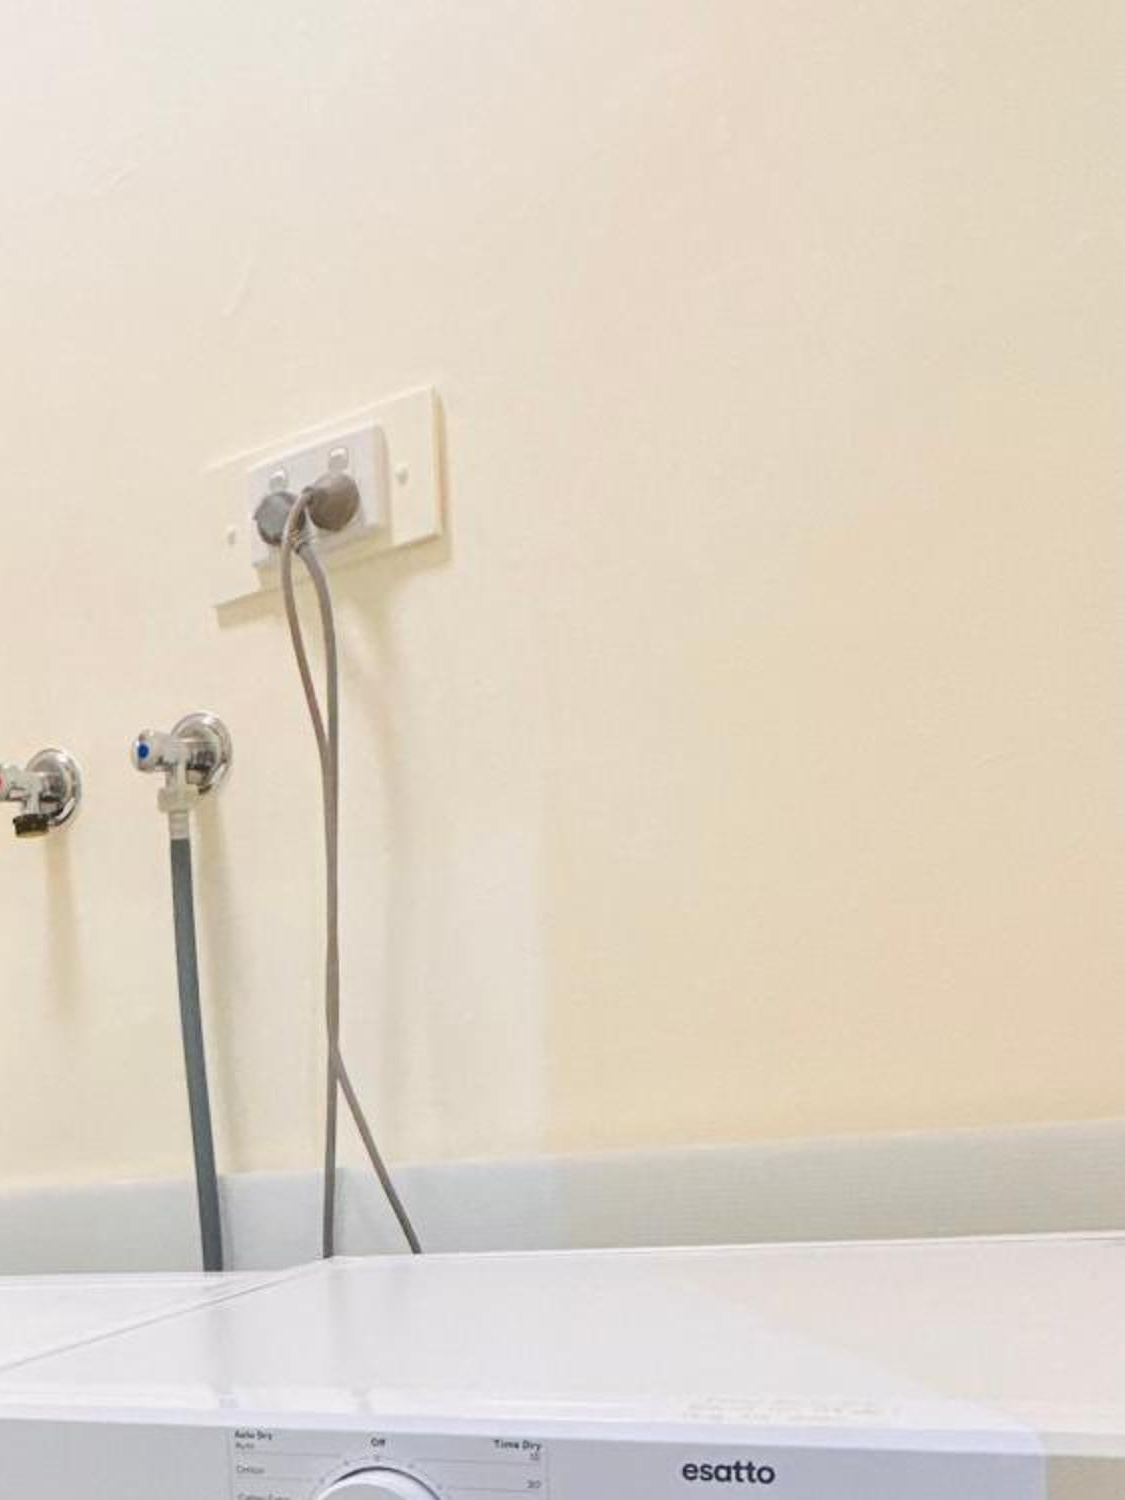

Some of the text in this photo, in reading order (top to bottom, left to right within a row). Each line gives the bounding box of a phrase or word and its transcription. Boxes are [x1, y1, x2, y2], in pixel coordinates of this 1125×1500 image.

[256, 1430, 273, 1441] Dry
[371, 1437, 386, 1448] Off
[493, 1438, 542, 1452] Time Dry
[681, 1460, 776, 1485] esatto
